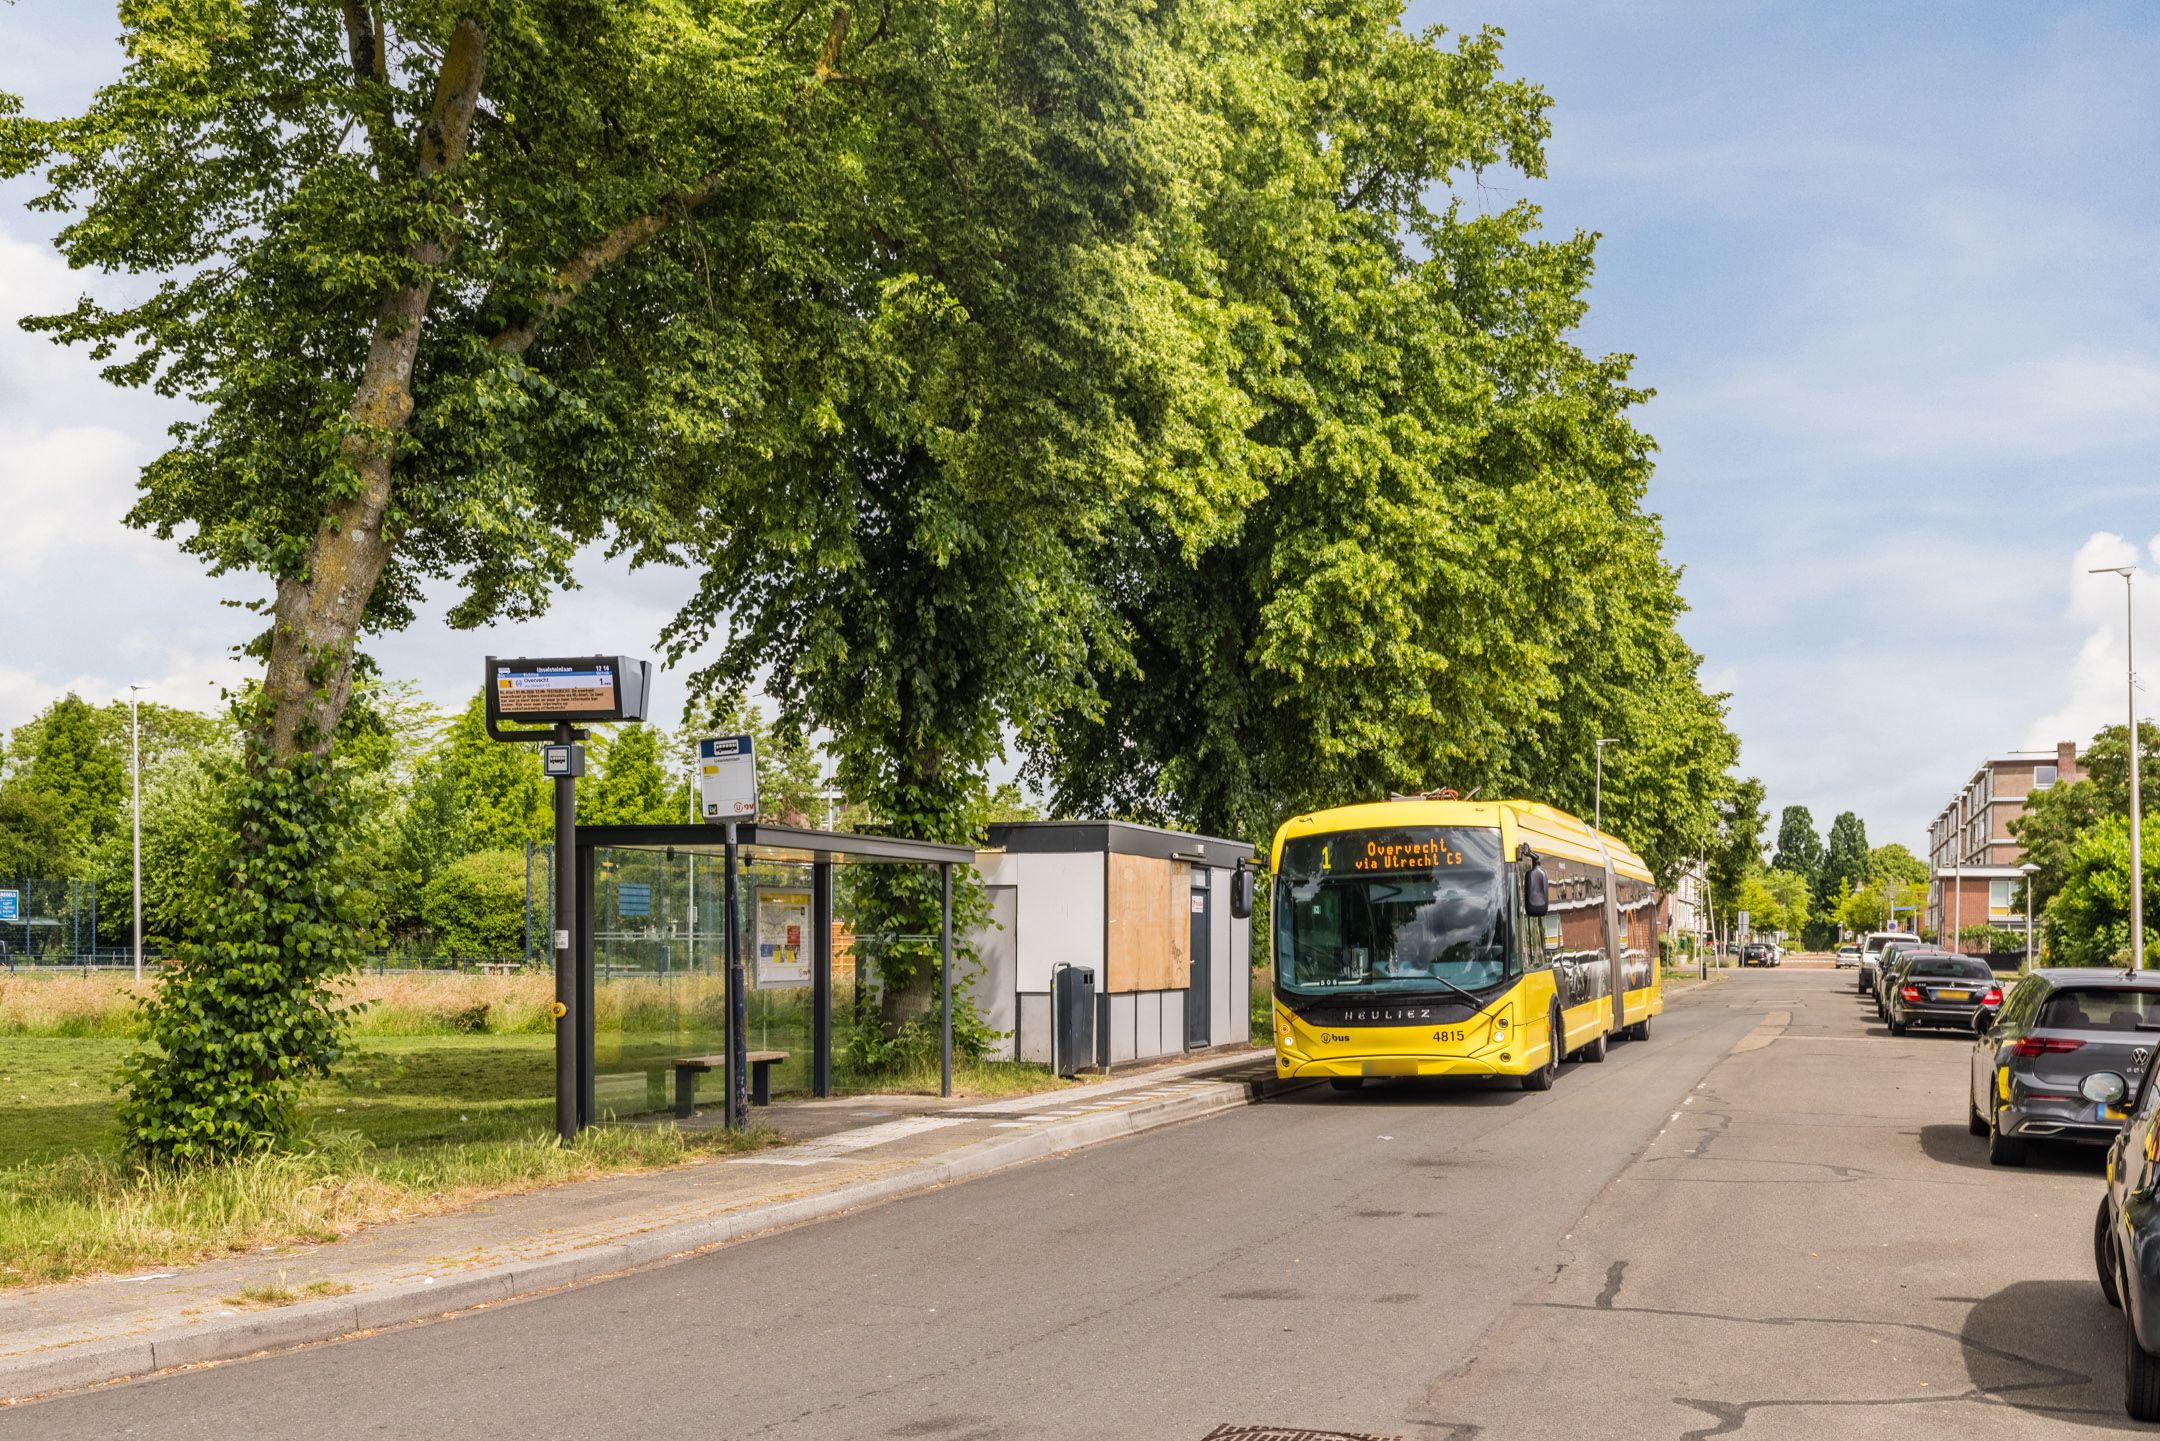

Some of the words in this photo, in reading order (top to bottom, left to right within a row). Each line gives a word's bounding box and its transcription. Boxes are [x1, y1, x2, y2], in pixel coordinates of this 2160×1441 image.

[1367, 837, 1447, 857] Overvecht
[1322, 846, 1332, 870] 1
[1355, 857, 1378, 870] via
[1384, 853, 1440, 869] Utrecht
[1446, 852, 1462, 865] CS
[1344, 1009, 1430, 1021] HEULIEZ
[1331, 1033, 1350, 1042] bus
[1432, 1030, 1464, 1042] 4815
